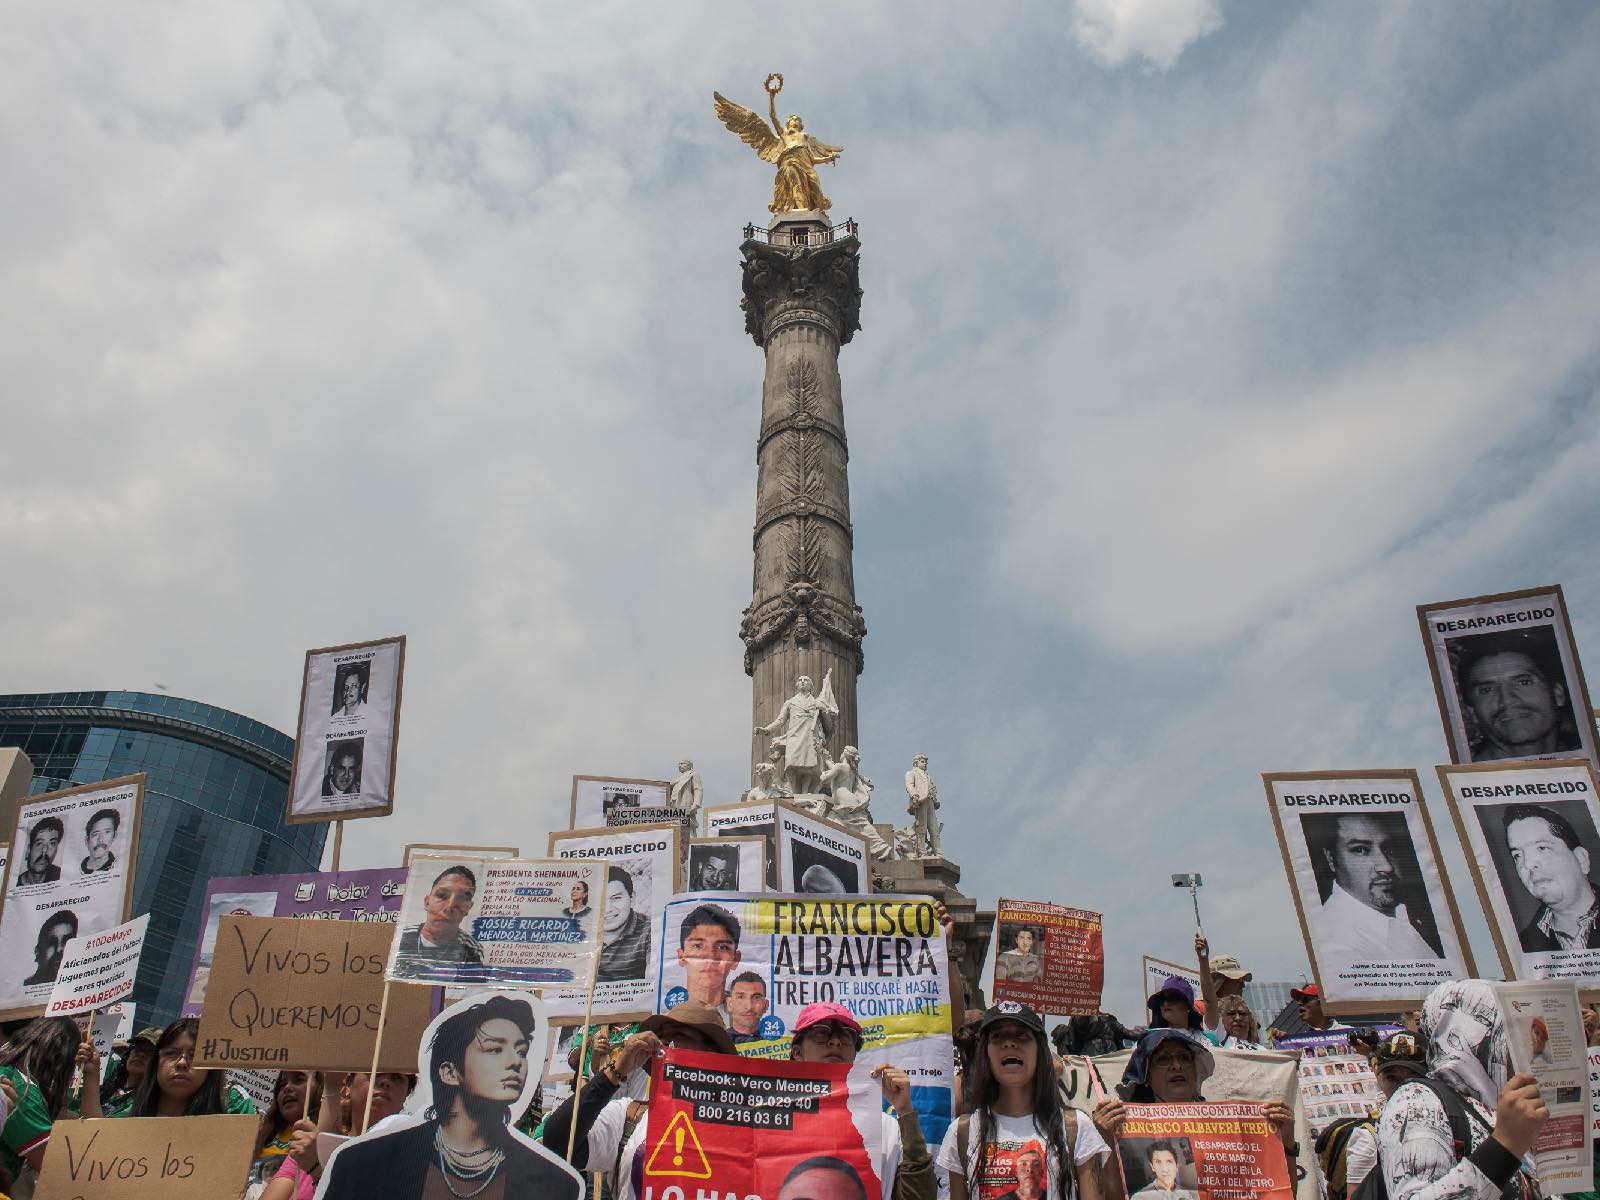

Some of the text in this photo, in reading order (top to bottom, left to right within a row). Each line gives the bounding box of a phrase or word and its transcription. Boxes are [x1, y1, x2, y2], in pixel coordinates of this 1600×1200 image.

[1437, 607, 1555, 633] DESAPARECIDO
[333, 652, 376, 663] DESAPARECIDO
[325, 729, 368, 739] DESAPARECIDO
[602, 786, 644, 794] DESAPARECIDO
[1460, 781, 1588, 798] DESAPARECIDO
[79, 792, 134, 808] DESAPARECIDO
[1283, 792, 1411, 807] DESAPARECIDO
[23, 803, 77, 819] DESAPARECIDO
[648, 808, 686, 818] ADRIÁN
[711, 812, 775, 827] DESAPARECI
[784, 819, 863, 860] DESAPARECIDO
[560, 841, 667, 859] DESAPARECIDO
[487, 869, 580, 879] PRESIDENTA SHEINBAUM,
[293, 879, 399, 902] El Dolor de
[526, 888, 550, 896] PUERTA
[35, 895, 91, 911] DESAPARECIDO
[350, 905, 400, 923] Tambie
[773, 902, 936, 938] FRANCISCO
[1000, 911, 1042, 922] FRANCISCO
[479, 915, 570, 931] JOSUÉ RICARDO
[85, 928, 132, 950] #10DeMayo
[477, 929, 528, 941] MENDOZA
[63, 951, 111, 969] Aficionados
[111, 946, 122, 957] del
[342, 941, 384, 975] los
[774, 935, 938, 977] ALBAVERA
[57, 951, 140, 984] juguemos por nuestros
[73, 971, 126, 993] seres queridos
[51, 978, 133, 1012] DESAPARECIDOS
[669, 991, 685, 1002] 22
[775, 978, 940, 1006] TREJO TE BUSCARÉ HASTA
[1042, 995, 1072, 1003] FRANCISCO
[840, 998, 940, 1017] ENCONTRARTE
[1038, 1004, 1067, 1014] 4288
[764, 1021, 780, 1031] 34
[666, 1064, 830, 1095] Facebook: Vero Mendez
[918, 1068, 943, 1077] Trejo
[233, 1072, 247, 1082] NOS
[246, 1077, 271, 1092] LLEVEN
[680, 1085, 812, 1110] Num: 800 89 029 40
[698, 1105, 791, 1127] 800 216 03 61
[1183, 1121, 1240, 1135] ALBAVERA
[1241, 1122, 1278, 1138] TREJO
[1251, 1143, 1262, 1152] EL
[160, 1142, 196, 1179] los
[992, 1158, 1013, 1166] HAS
[1205, 1152, 1256, 1164] 26 DE MARZO
[1203, 1164, 1262, 1176] DEL 2012 EN LA
[1227, 1177, 1244, 1187] DEL
[1244, 1178, 1275, 1188] METRO
